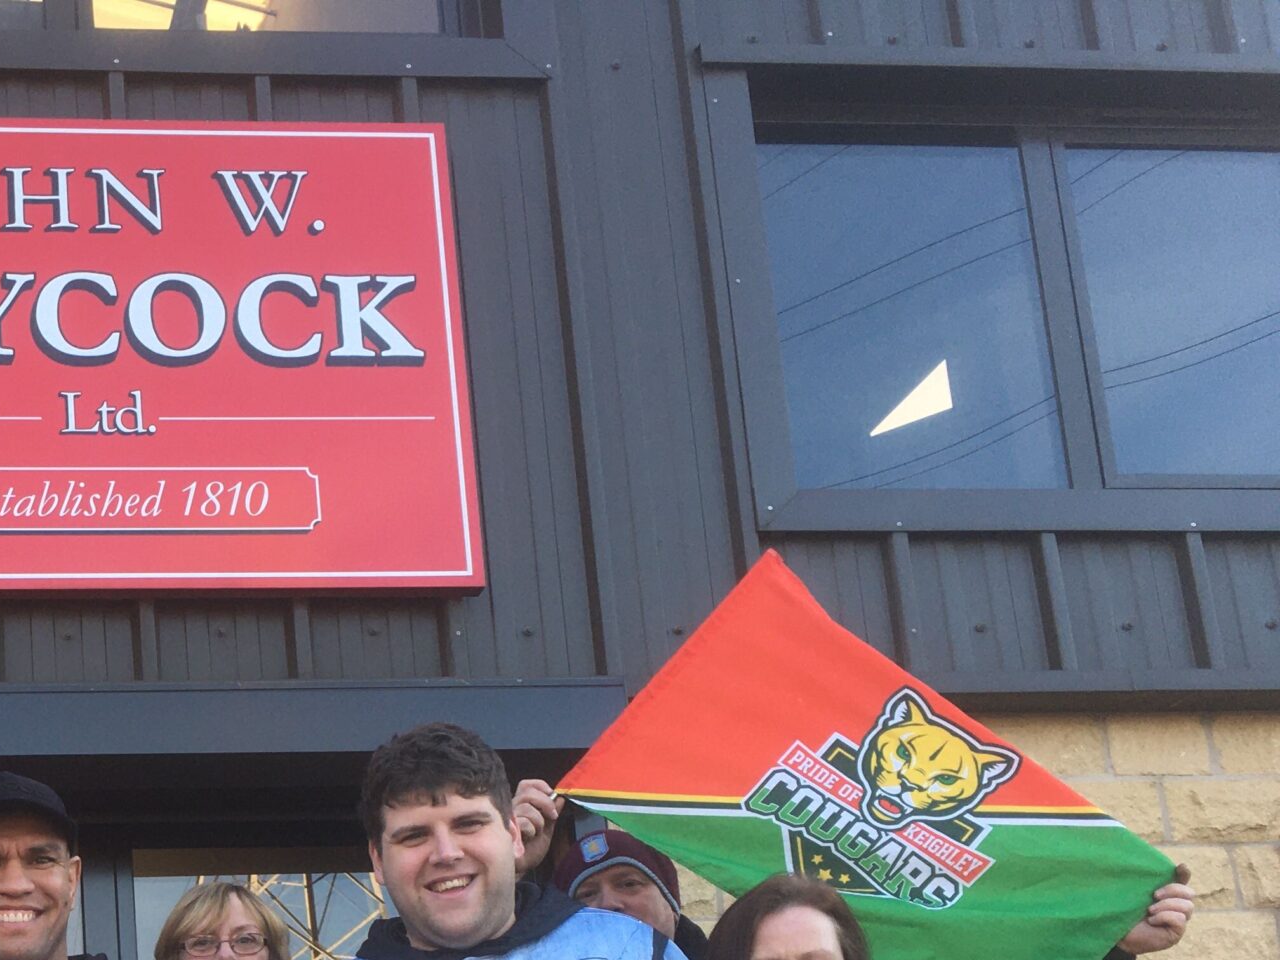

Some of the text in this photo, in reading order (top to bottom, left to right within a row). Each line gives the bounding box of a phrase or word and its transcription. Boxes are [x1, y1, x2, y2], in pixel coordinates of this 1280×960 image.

[215, 168, 327, 236] W.
[58, 389, 159, 436] Ltd.
[181, 479, 269, 517] 1810
[748, 769, 962, 909] COUGARS
[787, 749, 984, 877] PRIDE OF KEIGHLEY
